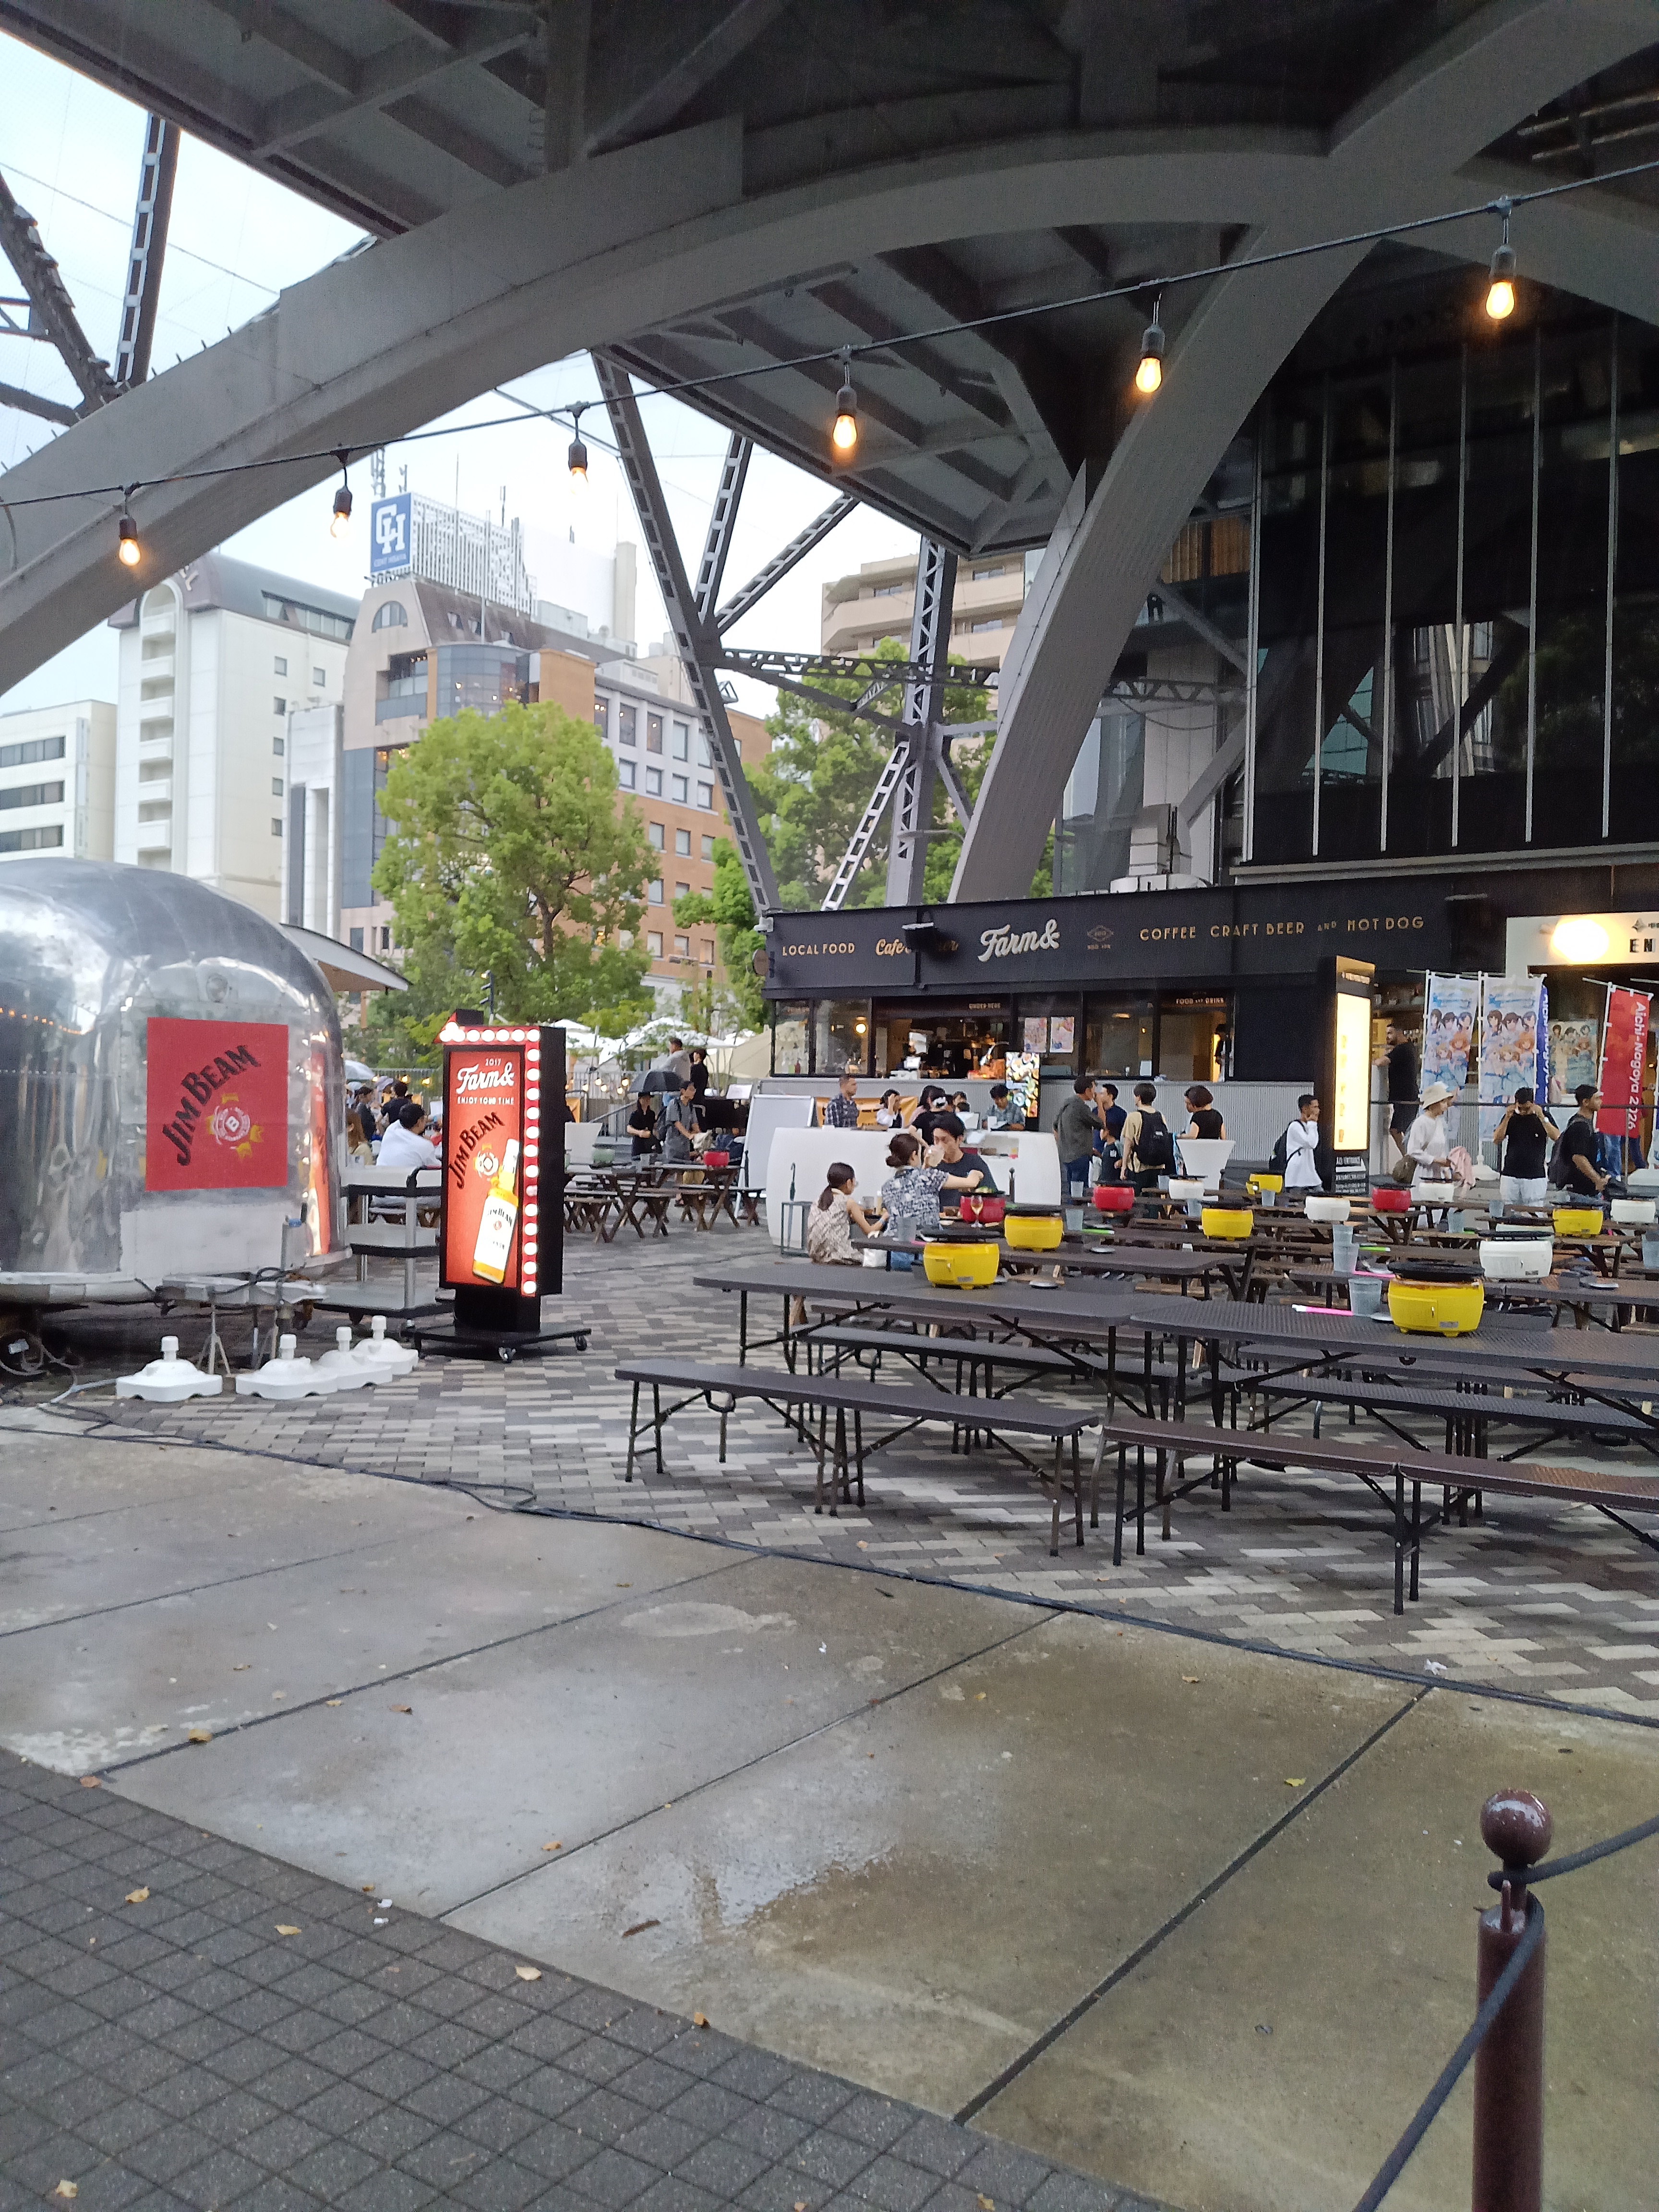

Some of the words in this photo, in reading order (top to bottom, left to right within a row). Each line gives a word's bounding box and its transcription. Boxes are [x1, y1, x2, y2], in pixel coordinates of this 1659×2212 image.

[977, 919, 1060, 962] Farm&
[1140, 926, 1196, 941] COFFEE
[1210, 923, 1258, 938] CRAFT
[1266, 921, 1305, 936] BEER
[1347, 918, 1379, 932] HOT
[1385, 916, 1424, 930] DOG
[782, 944, 819, 956] LOCAL
[822, 942, 855, 954] FOOD
[876, 938, 904, 957] Cafe
[485, 1058, 502, 1066] 2017
[1629, 1001, 1647, 1094] Aichi-Nagoya
[181, 1045, 261, 1106] BEAM
[456, 1061, 515, 1094] Farm&
[457, 1096, 478, 1105] ENJOY
[480, 1096, 496, 1105] YOUR
[498, 1096, 514, 1106] TIME
[162, 1096, 202, 1166] JIM
[459, 1111, 505, 1152] BEAM
[449, 1144, 470, 1190] JIM
